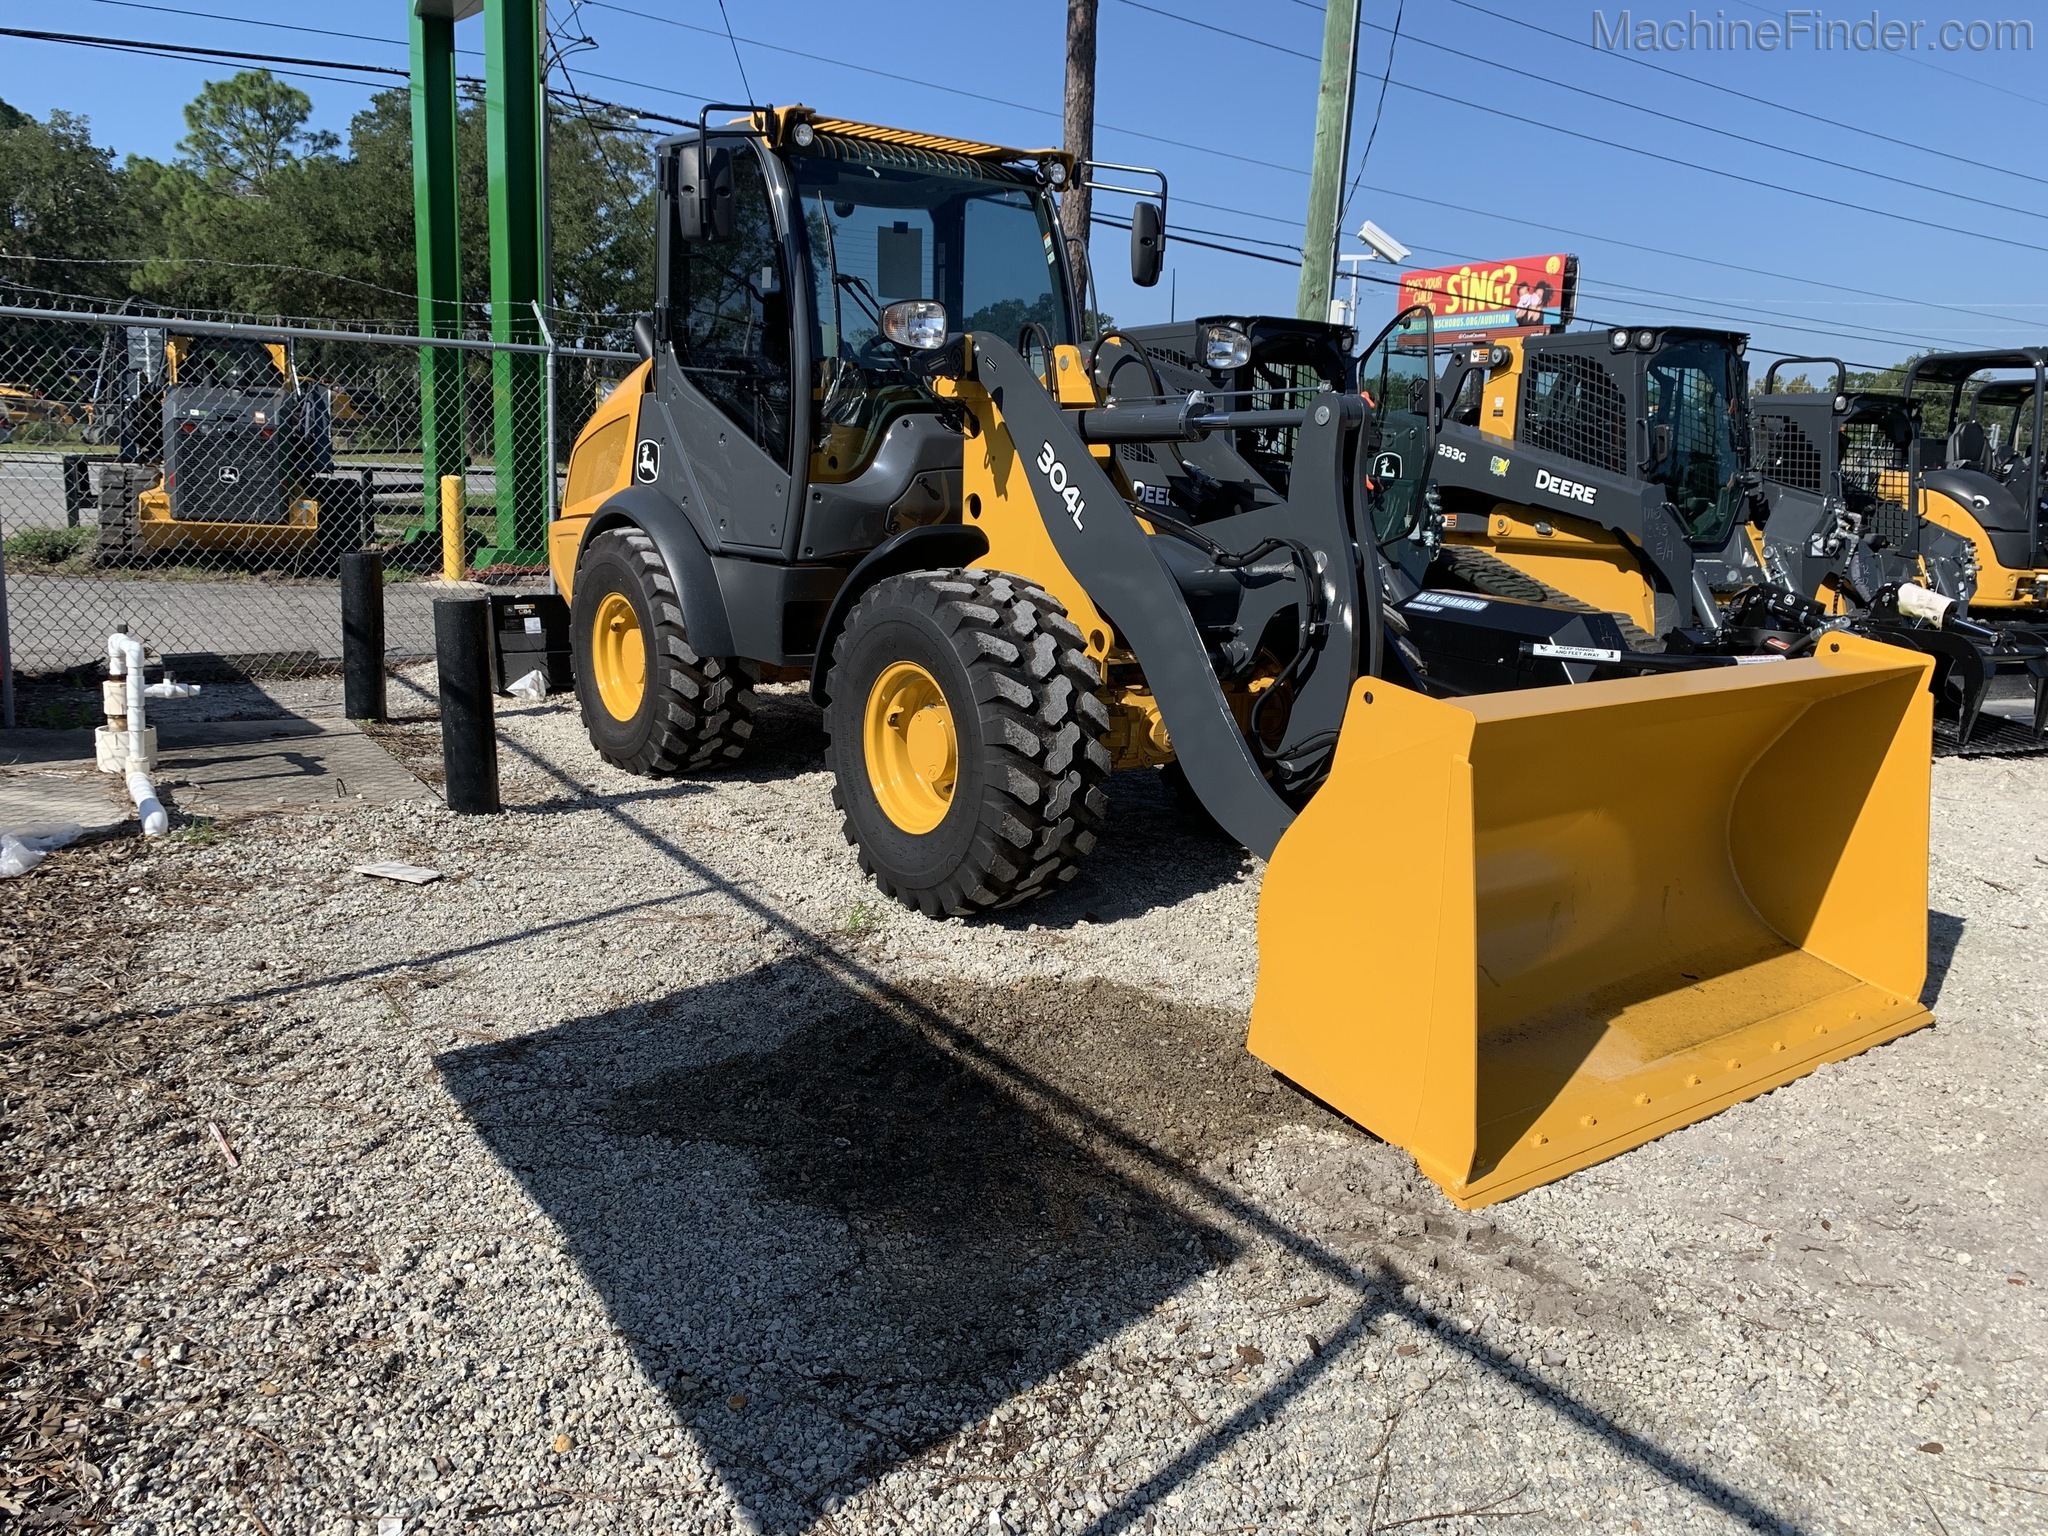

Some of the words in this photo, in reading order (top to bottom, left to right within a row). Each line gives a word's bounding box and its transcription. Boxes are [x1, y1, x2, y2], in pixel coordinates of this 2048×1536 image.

[1425, 275, 1443, 290] YOUR
[1438, 443, 1467, 463] 333G
[1037, 440, 1086, 532] 304L
[1535, 468, 1597, 505] DEERE
[1415, 592, 1443, 604] BLUE
[1439, 596, 1488, 611] DIAMOND
